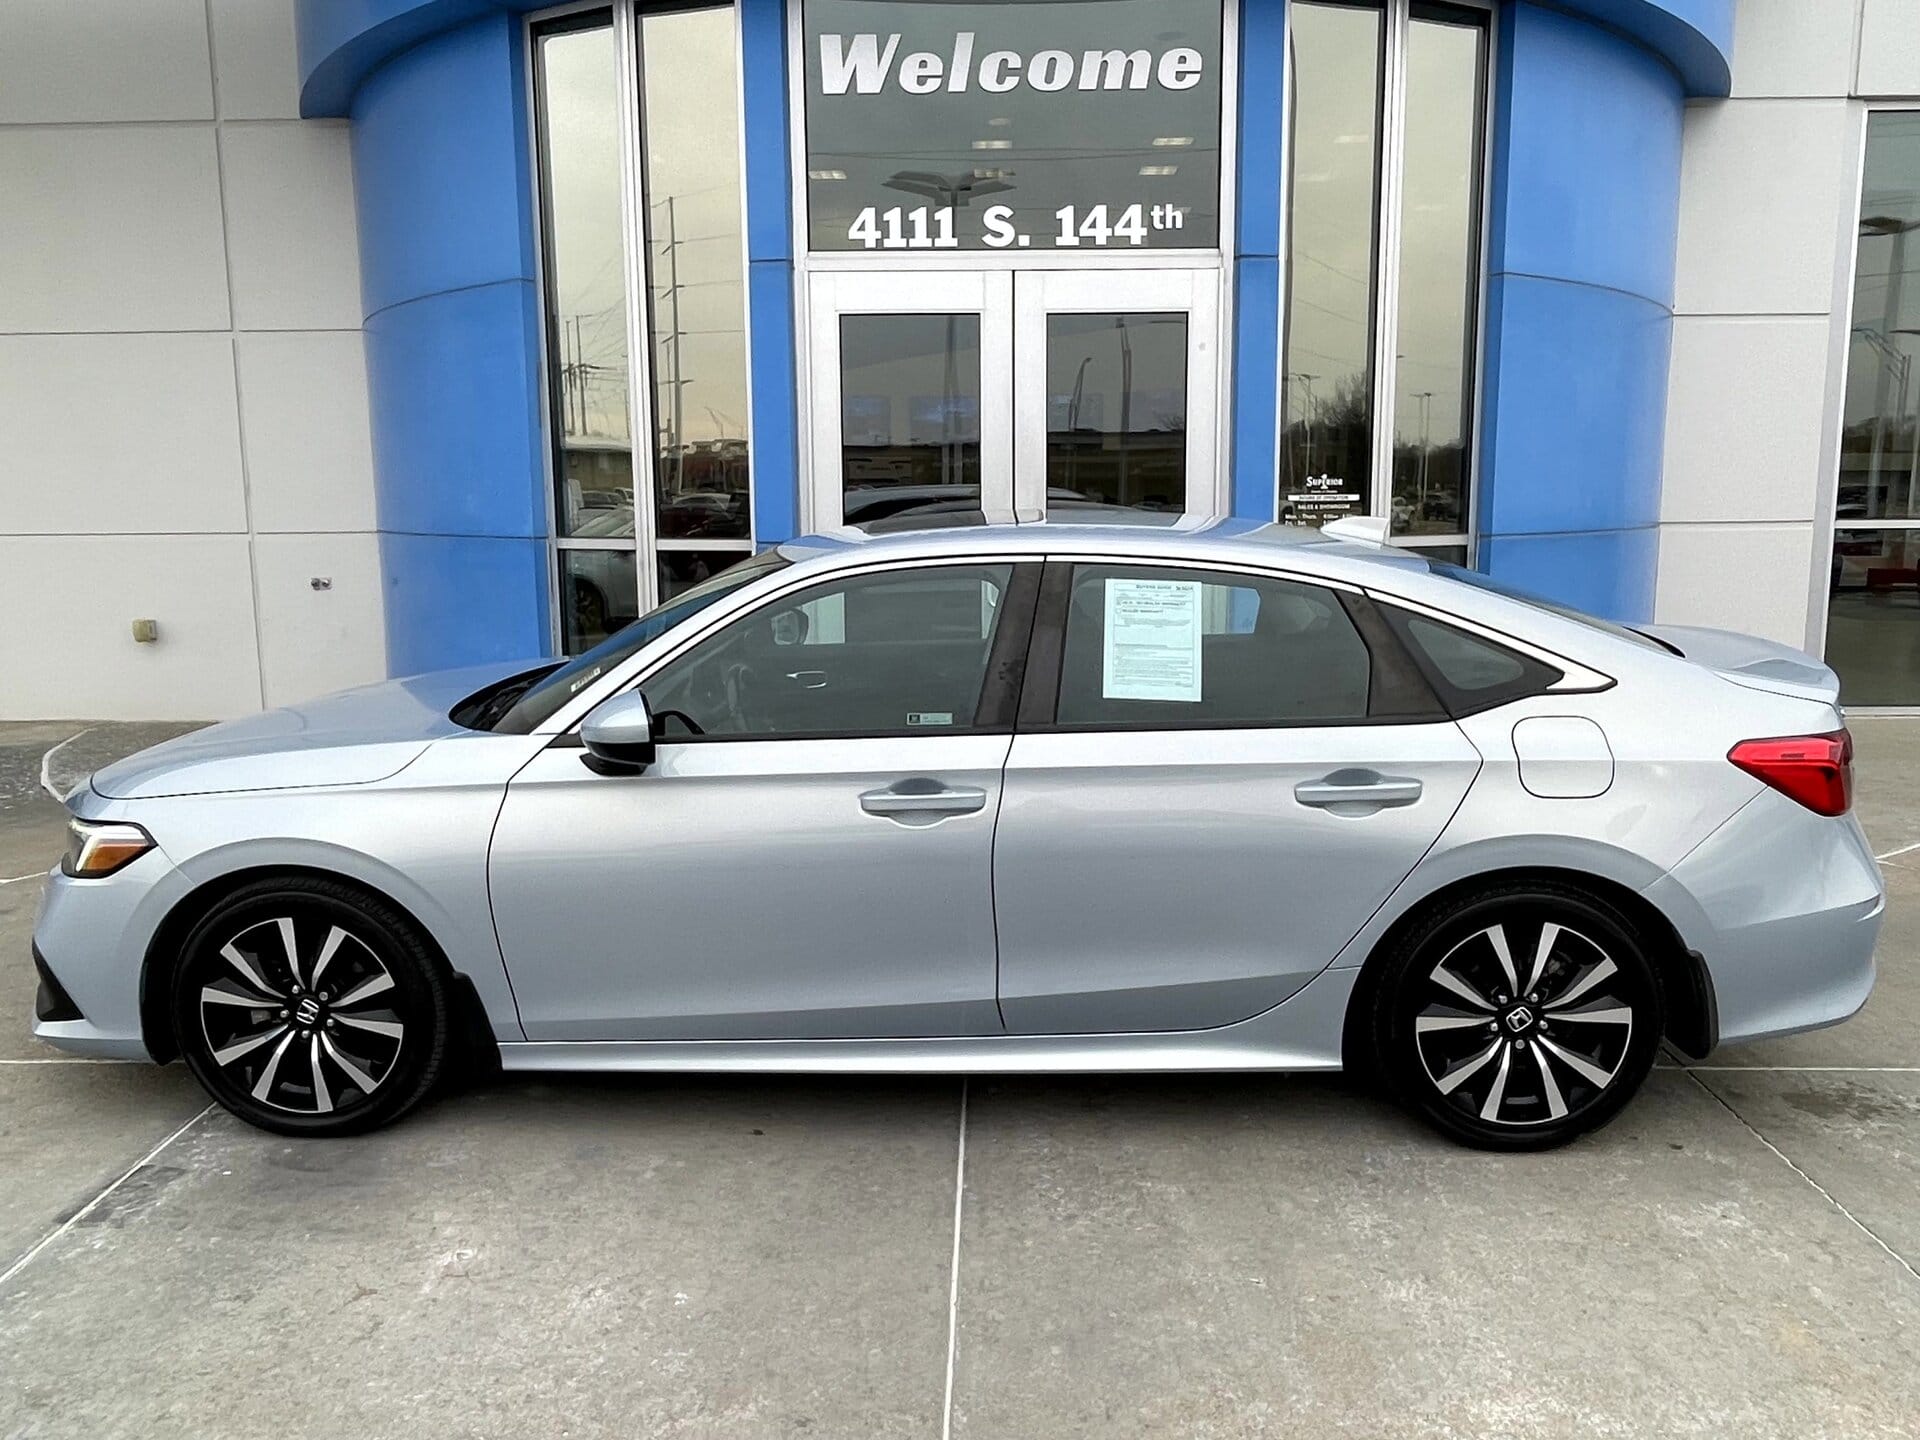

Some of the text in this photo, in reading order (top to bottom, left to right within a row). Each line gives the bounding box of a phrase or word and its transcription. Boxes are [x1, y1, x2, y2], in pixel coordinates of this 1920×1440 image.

[819, 32, 1203, 95] Welcome
[848, 203, 1184, 249] 4111 S. 144th
